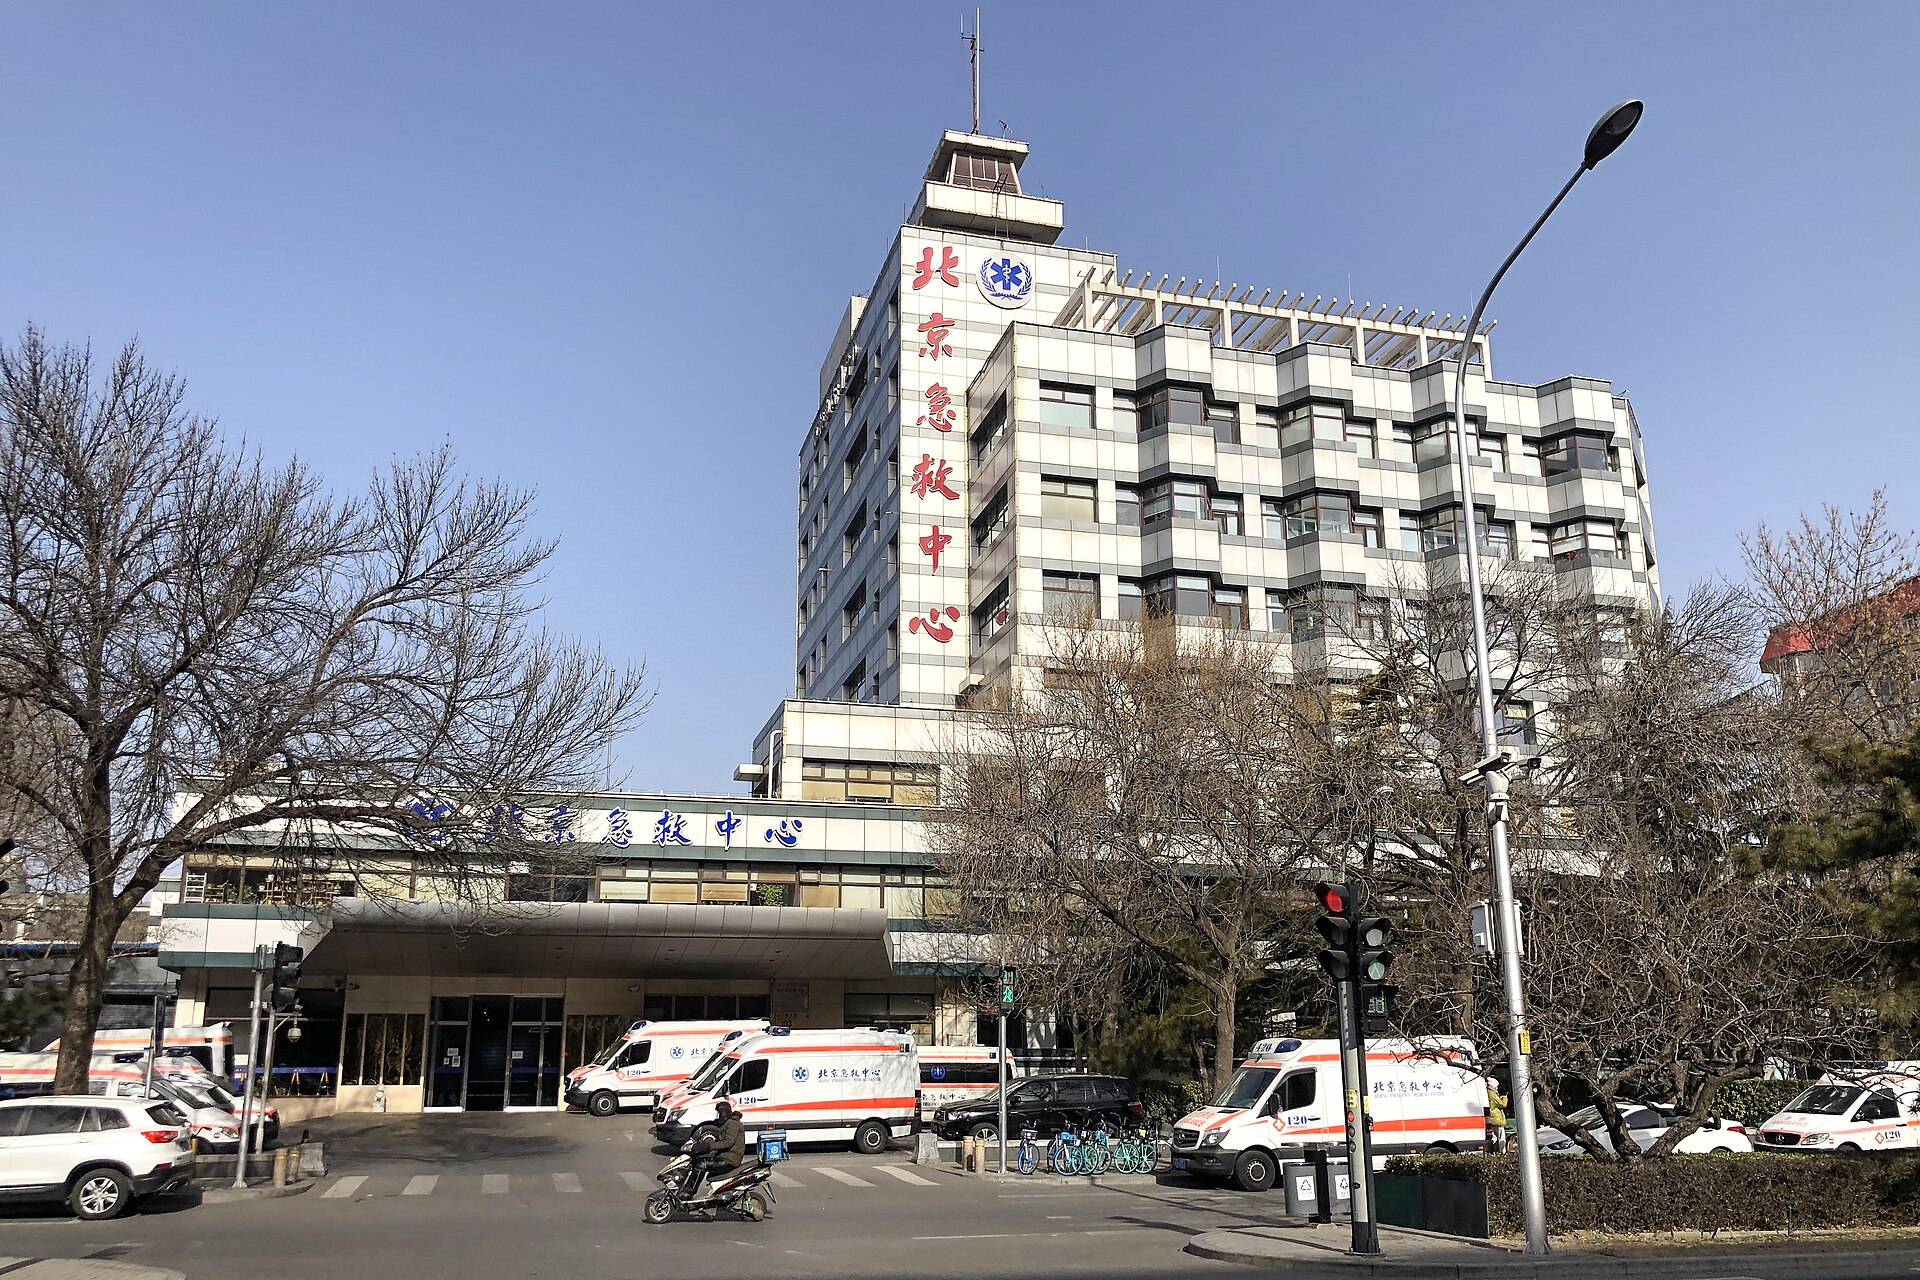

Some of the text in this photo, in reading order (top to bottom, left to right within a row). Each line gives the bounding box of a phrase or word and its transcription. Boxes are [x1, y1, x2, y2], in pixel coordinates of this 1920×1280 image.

[909, 246, 961, 644] 北京急救中心
[818, 1067, 881, 1079] 北京急救中心
[1373, 1080, 1443, 1094] 北京急救中心
[738, 1096, 757, 1104] 120
[1287, 1115, 1308, 1126] 120
[1884, 1130, 1901, 1139] 120
